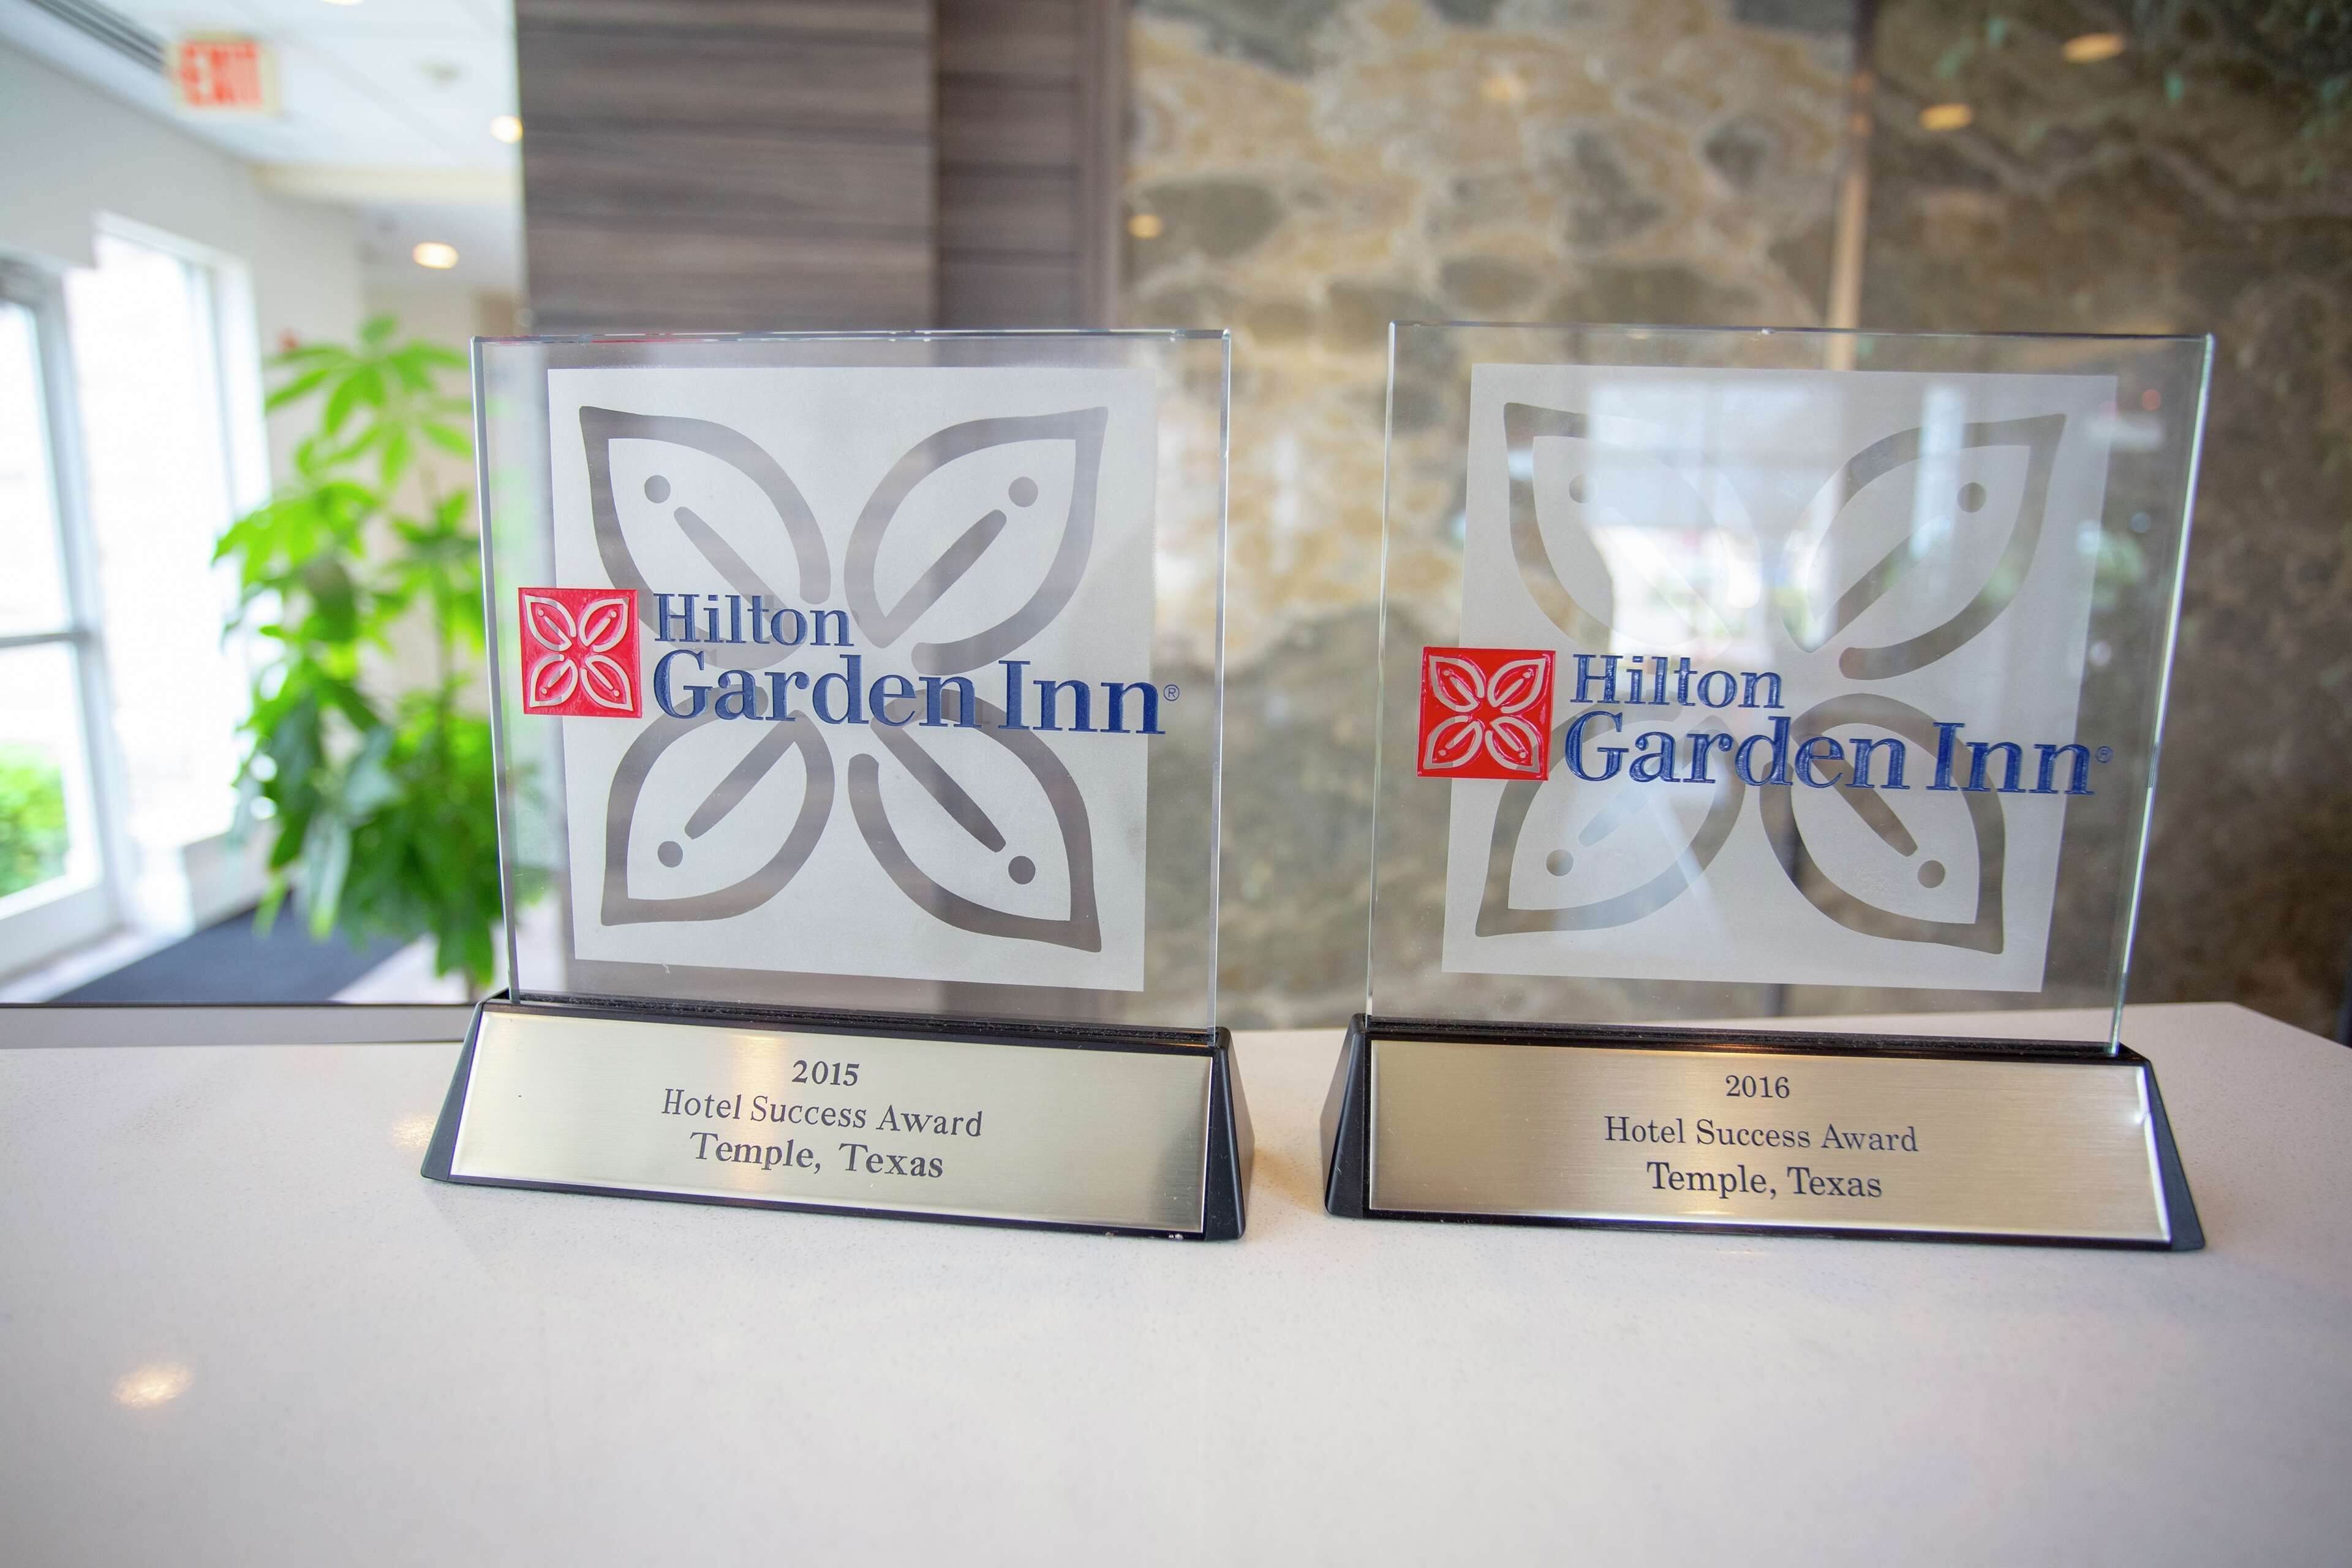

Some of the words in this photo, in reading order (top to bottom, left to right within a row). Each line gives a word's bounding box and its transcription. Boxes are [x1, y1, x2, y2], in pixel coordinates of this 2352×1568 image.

[654, 593, 854, 647] Hilton
[653, 649, 982, 729] Garden
[1570, 654, 1785, 709] Hilton
[1565, 710, 1911, 791] Garden
[791, 1060, 861, 1087] 2015
[1725, 1074, 1790, 1099] 2016
[661, 1088, 742, 1120] Hotel
[750, 1095, 867, 1129] Success
[875, 1104, 983, 1137] Award
[1604, 1115, 1686, 1144] Hotel
[1695, 1118, 1811, 1148] Success
[1820, 1123, 1919, 1152] Award
[689, 1131, 822, 1174] Temple,
[838, 1143, 944, 1178] Texas
[1646, 1161, 1777, 1199] Temple,
[1786, 1166, 1883, 1198] Texas
